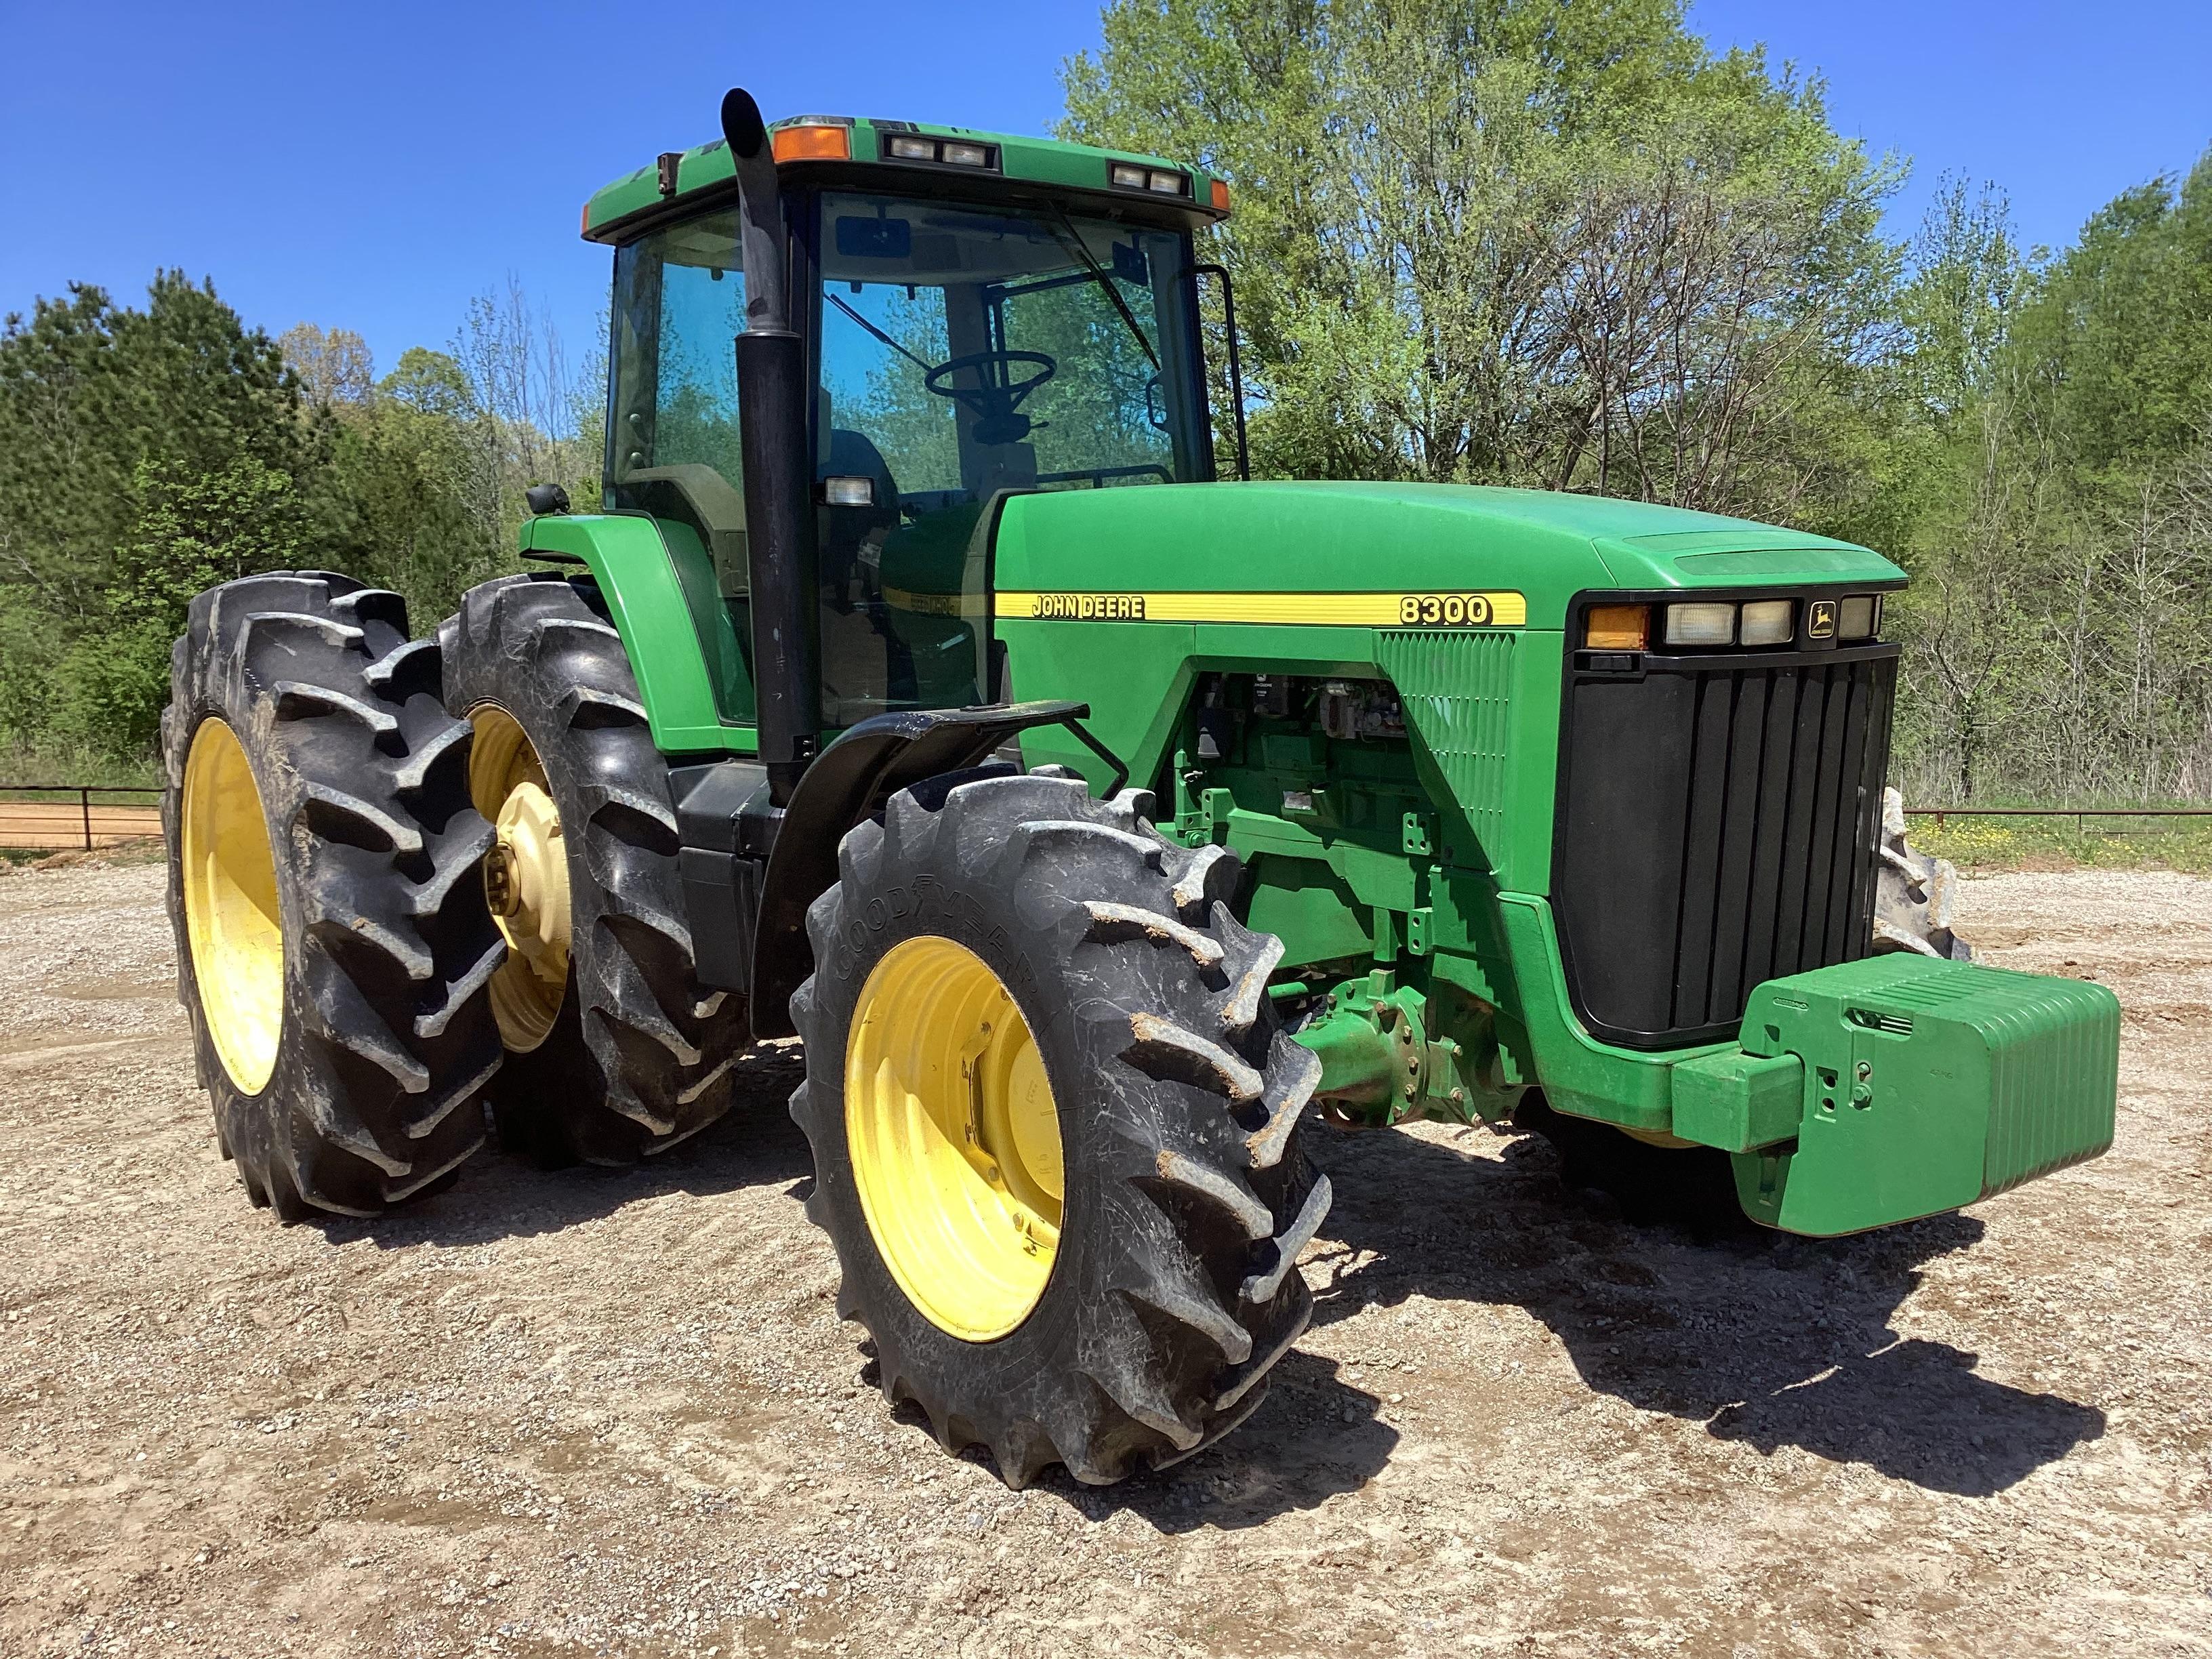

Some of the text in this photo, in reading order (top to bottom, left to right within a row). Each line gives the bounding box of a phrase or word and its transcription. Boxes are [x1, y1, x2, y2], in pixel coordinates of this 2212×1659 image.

[1032, 595, 1145, 620] JOHN DEERE
[1400, 595, 1493, 626] 8300
[834, 880, 1039, 994] GOODYEAR
